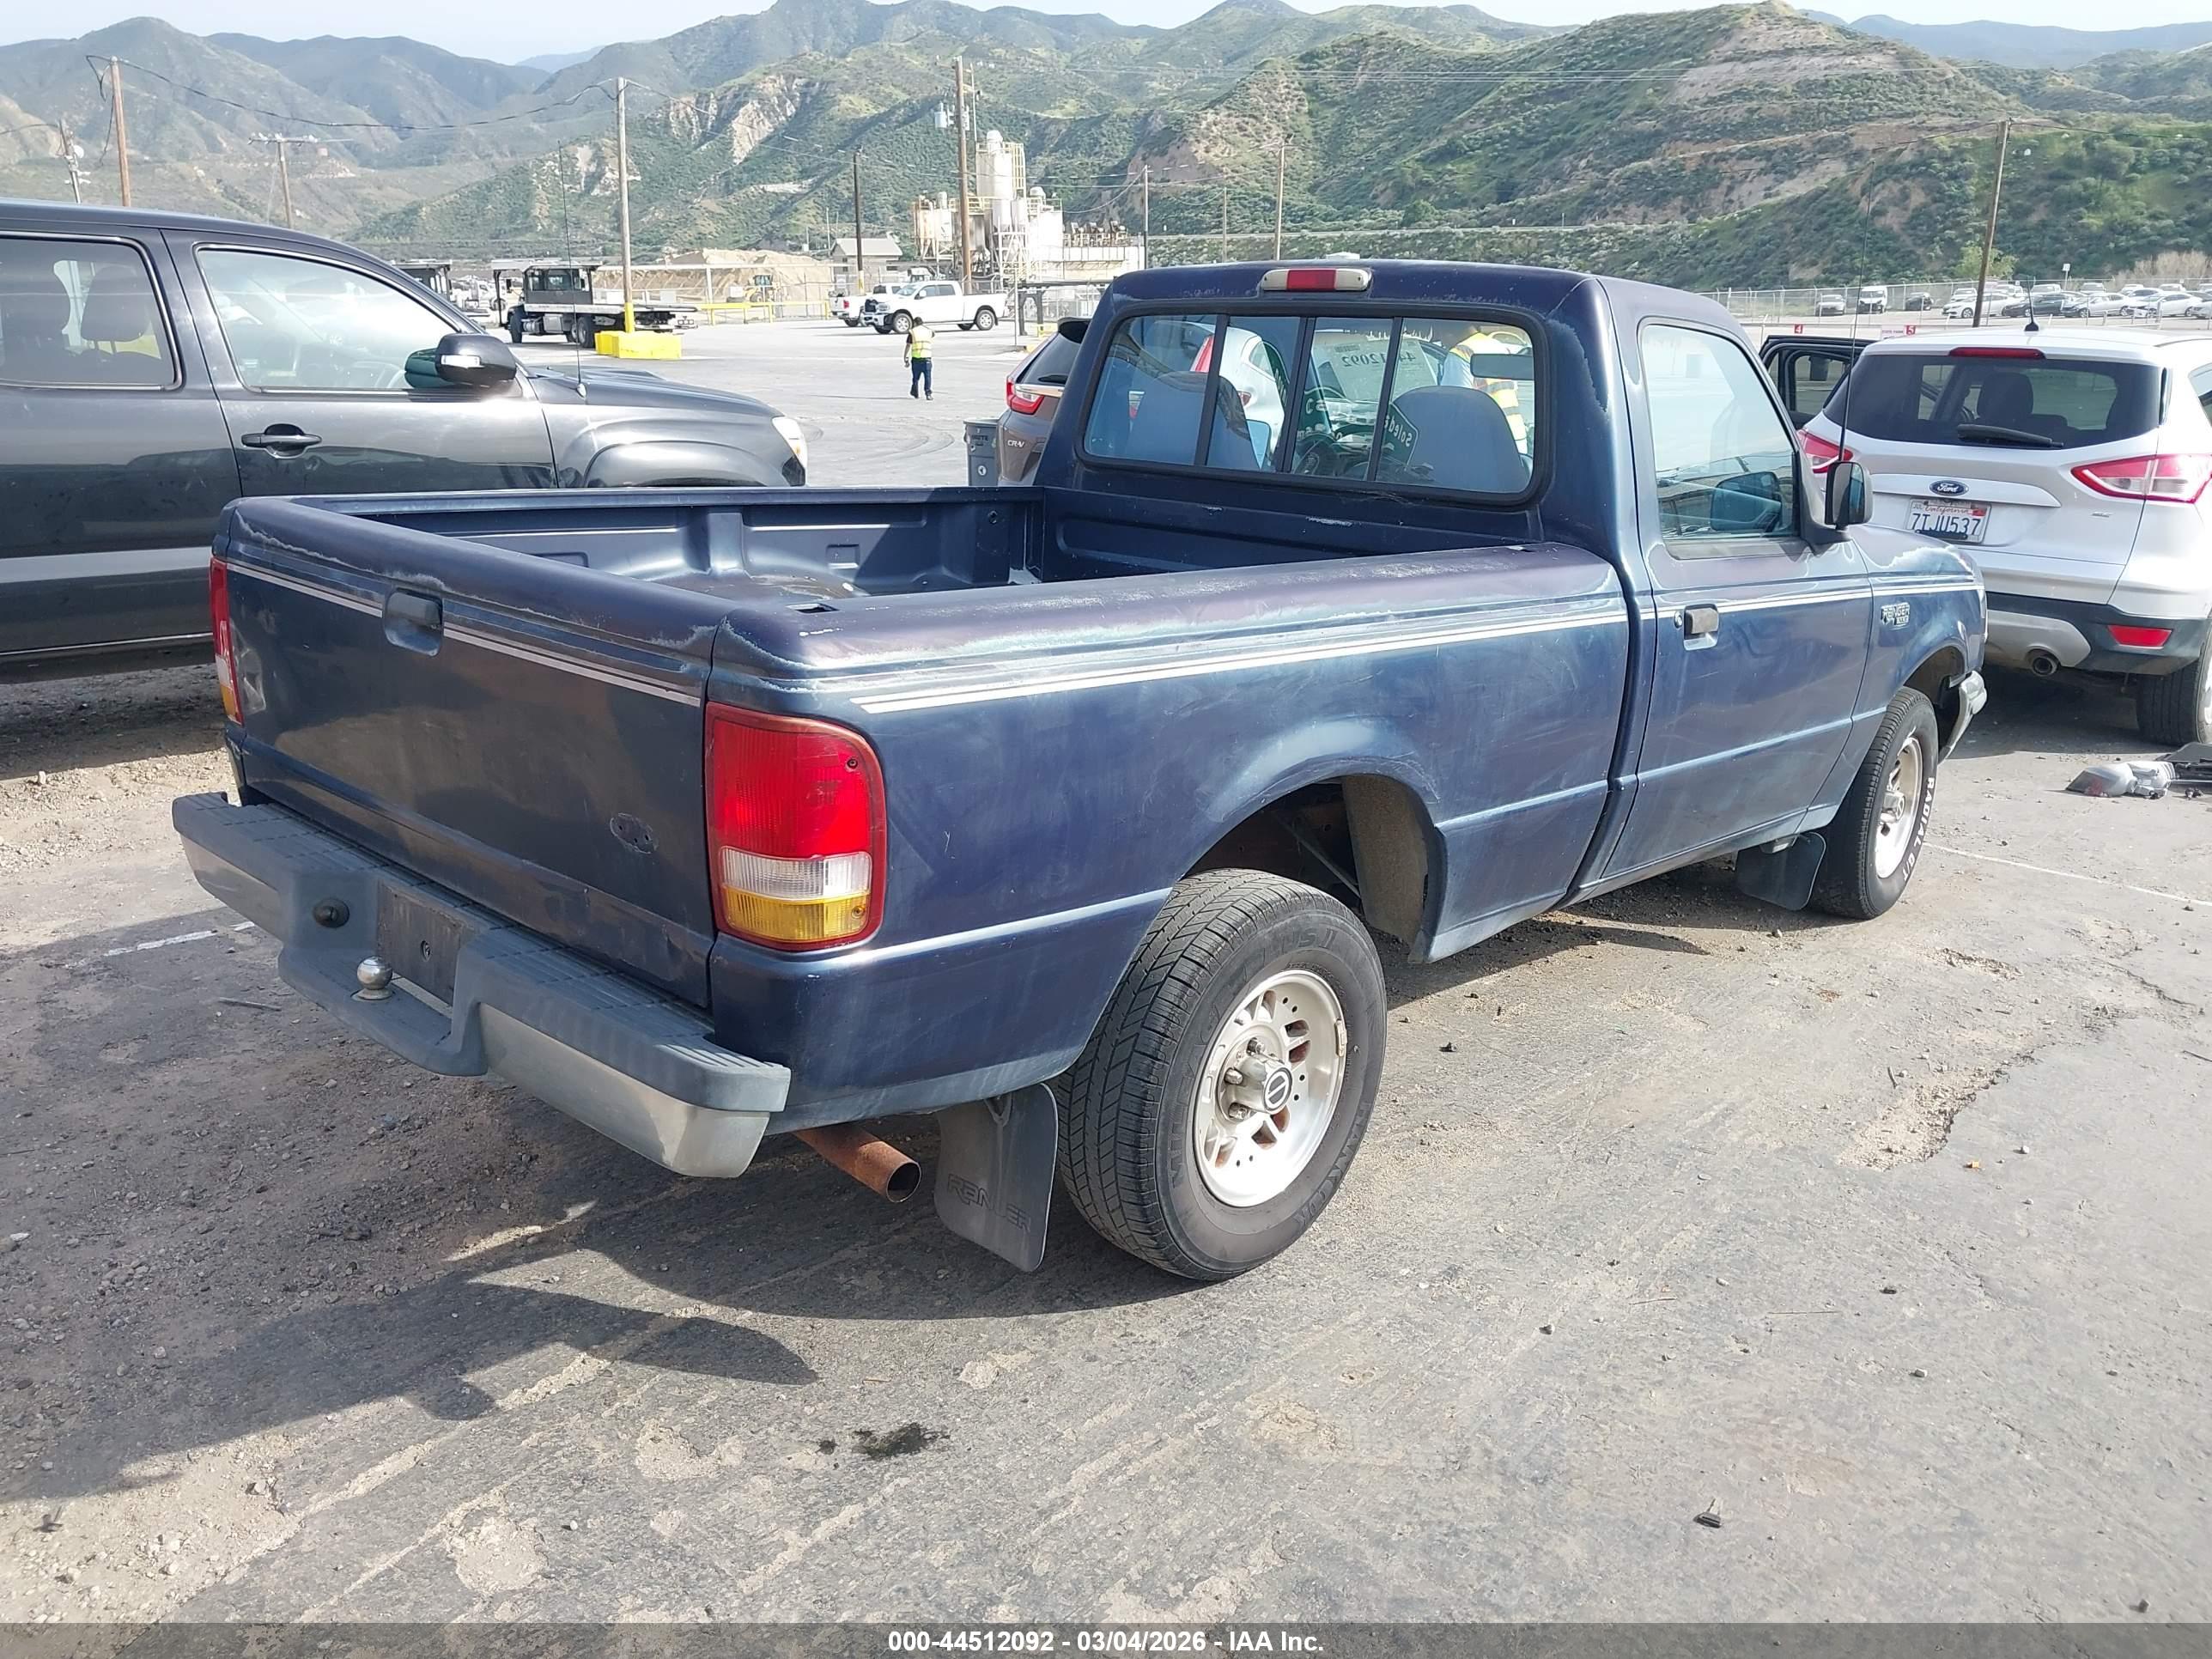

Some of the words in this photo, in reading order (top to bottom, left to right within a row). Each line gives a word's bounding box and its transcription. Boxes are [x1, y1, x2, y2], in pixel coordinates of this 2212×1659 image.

[1937, 483, 1960, 493] Ford
[1925, 505, 1969, 515] California
[1912, 514, 1981, 536] 7TJU537
[1881, 602, 1910, 625] RANGER
[1914, 777, 1935, 847] RADIAL
